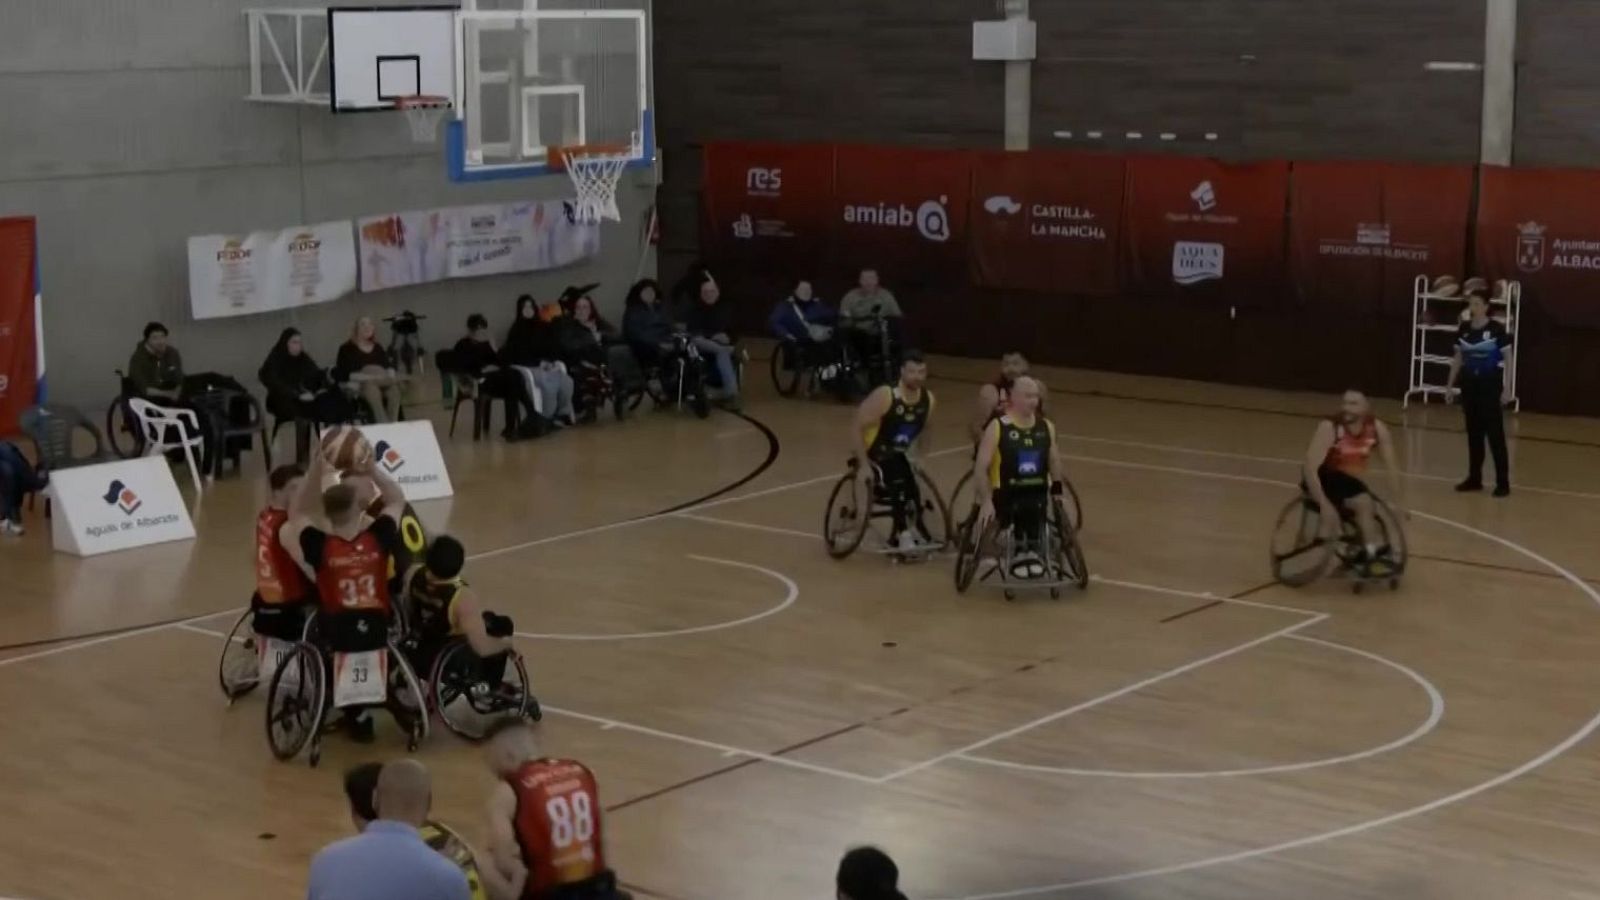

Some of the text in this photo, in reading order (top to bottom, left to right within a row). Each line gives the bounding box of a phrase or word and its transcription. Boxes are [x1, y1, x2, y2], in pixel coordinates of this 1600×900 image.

[747, 167, 782, 190] res
[843, 202, 914, 227] amiab
[1032, 204, 1095, 219] CASTILLA-
[1031, 223, 1107, 240] LA MANCHA
[339, 574, 378, 607] 33
[351, 667, 369, 683] 33
[546, 791, 594, 848] 88
